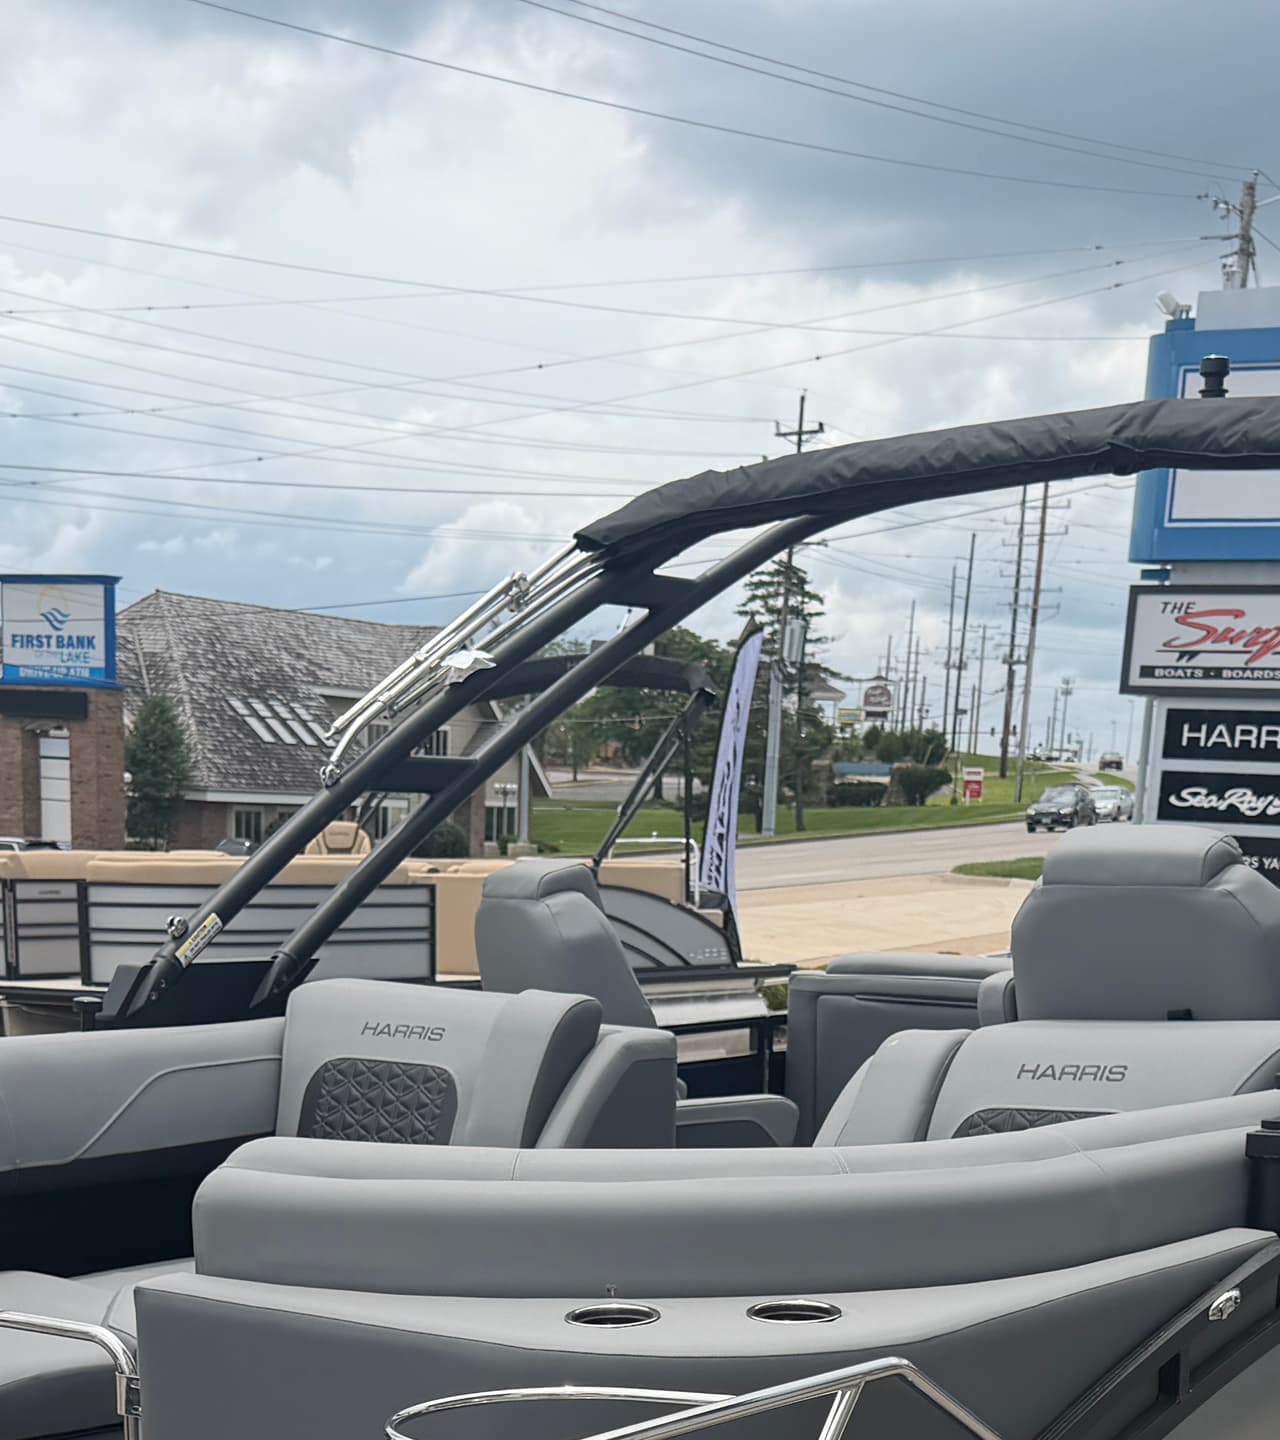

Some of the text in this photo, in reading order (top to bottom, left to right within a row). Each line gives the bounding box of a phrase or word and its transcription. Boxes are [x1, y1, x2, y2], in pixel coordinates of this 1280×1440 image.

[1160, 601, 1196, 615] THE
[11, 634, 96, 650] FIRST BANK
[60, 651, 90, 664] LAKE
[1154, 667, 1204, 679] BOATS
[360, 1021, 446, 1042] HARRIS
[1016, 1063, 1129, 1083] HARRIS
